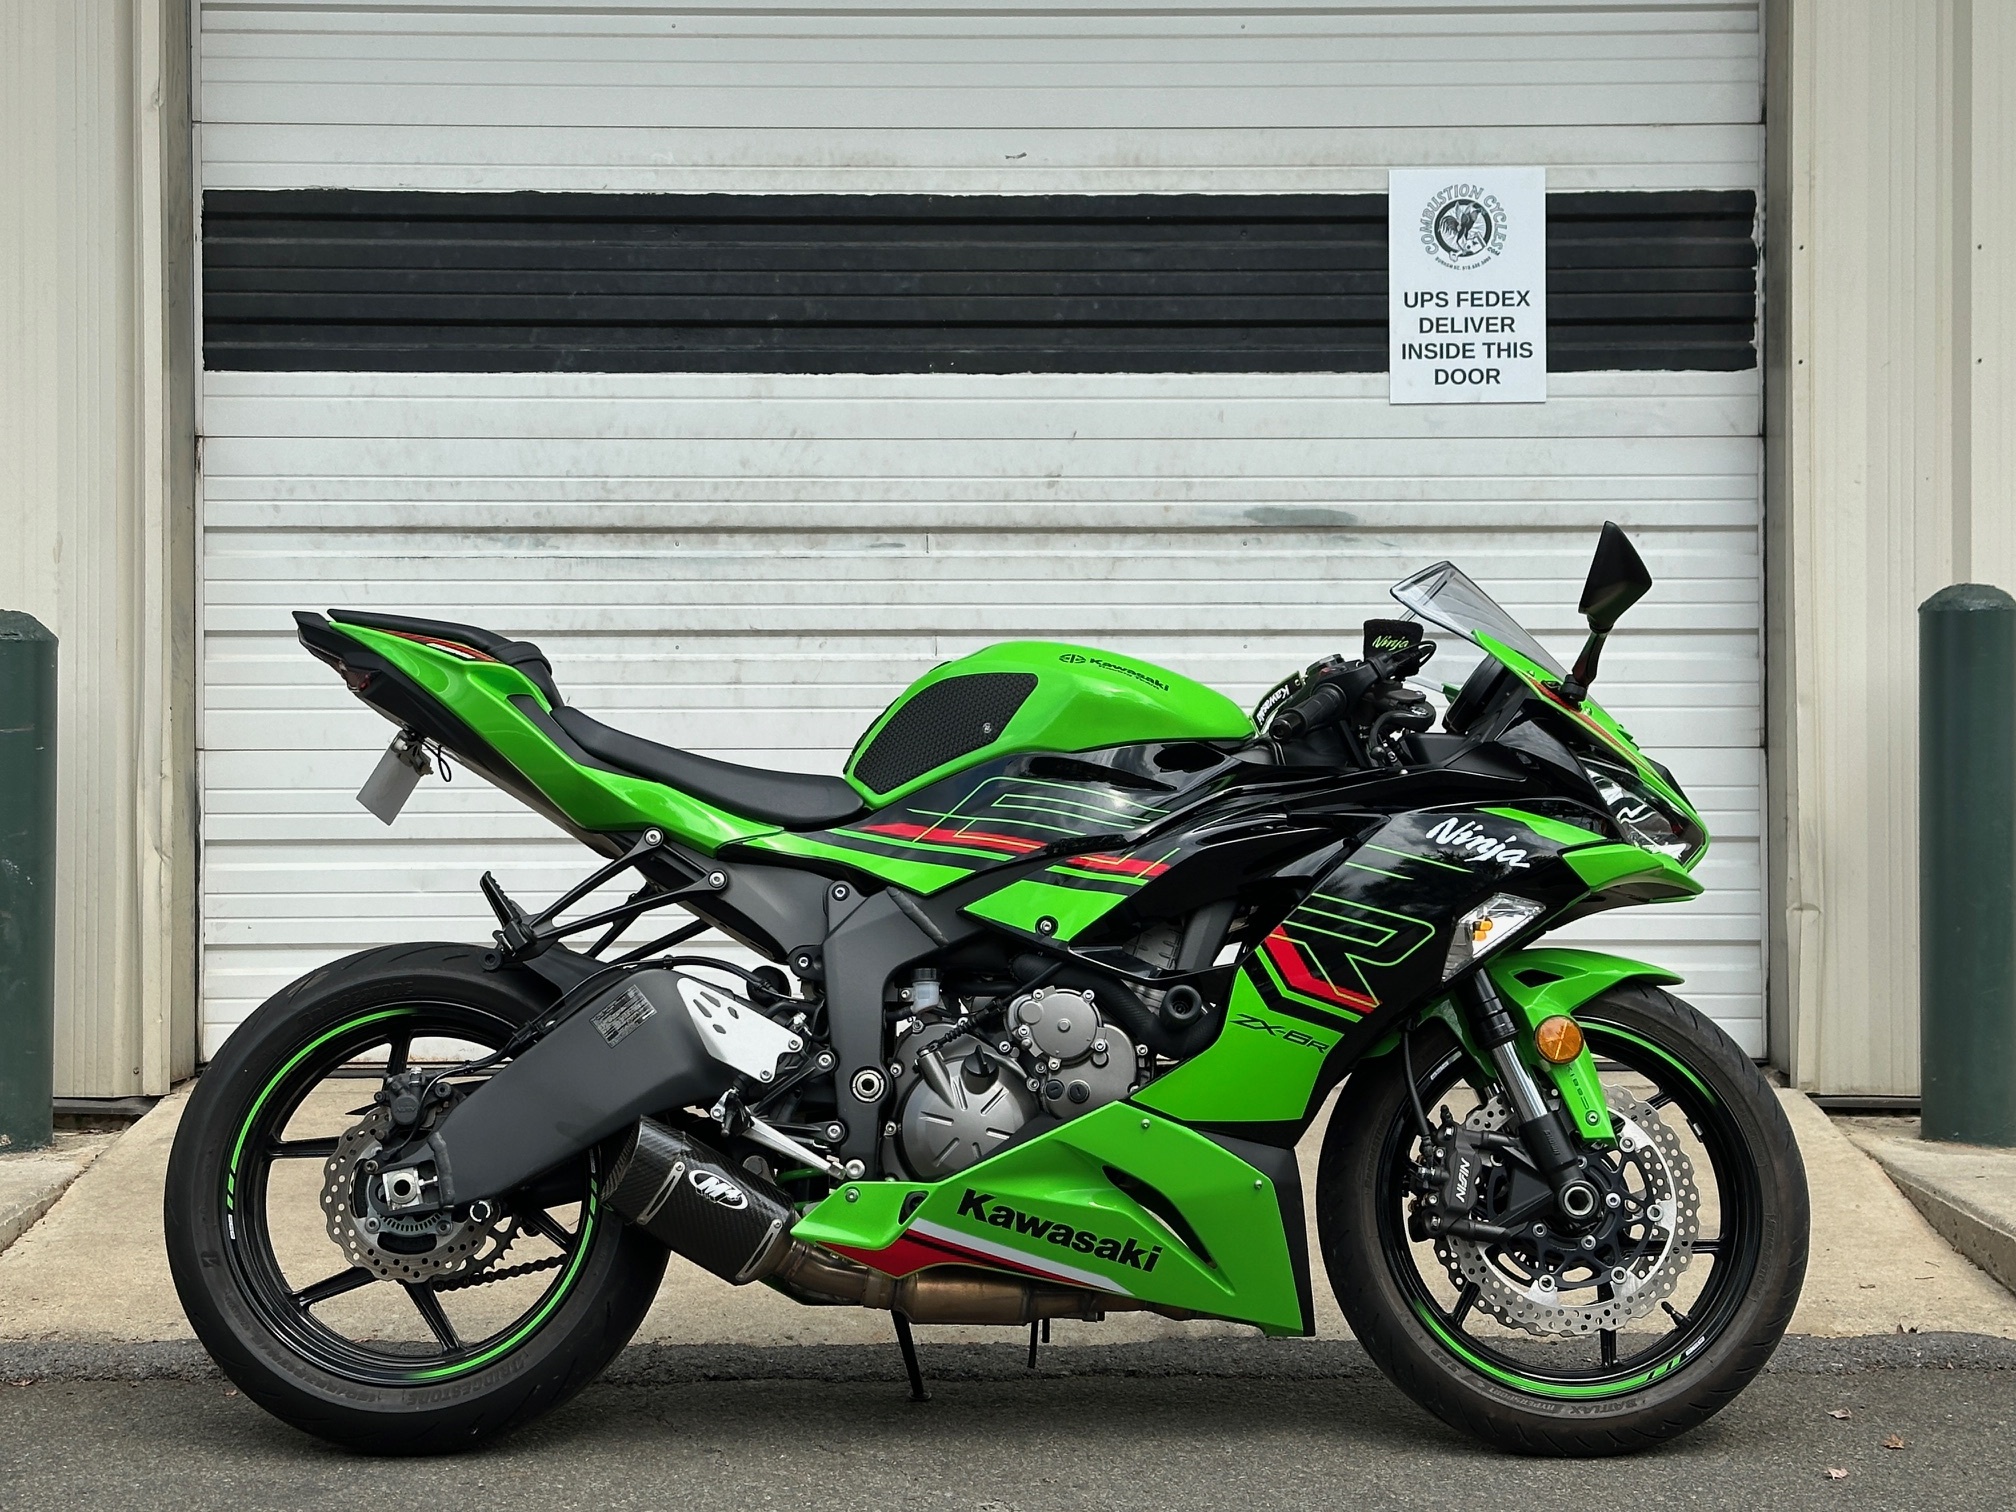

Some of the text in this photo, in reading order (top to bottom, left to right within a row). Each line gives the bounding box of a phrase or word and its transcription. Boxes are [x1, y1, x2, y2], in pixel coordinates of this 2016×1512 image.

[1419, 183, 1508, 255] COMBUSTION CYCLES
[1403, 290, 1531, 308] UPS FEDEX
[1418, 316, 1516, 334] DELIVER
[1401, 341, 1534, 360] INSIDE THIS
[1434, 368, 1501, 385] DOOR
[1372, 635, 1410, 651] Ninja
[1090, 658, 1170, 692] Kawasaki
[1425, 816, 1531, 869] Ninja
[1230, 1012, 1330, 1055] ZX-6R
[956, 1187, 1164, 1273] Kawasaki
